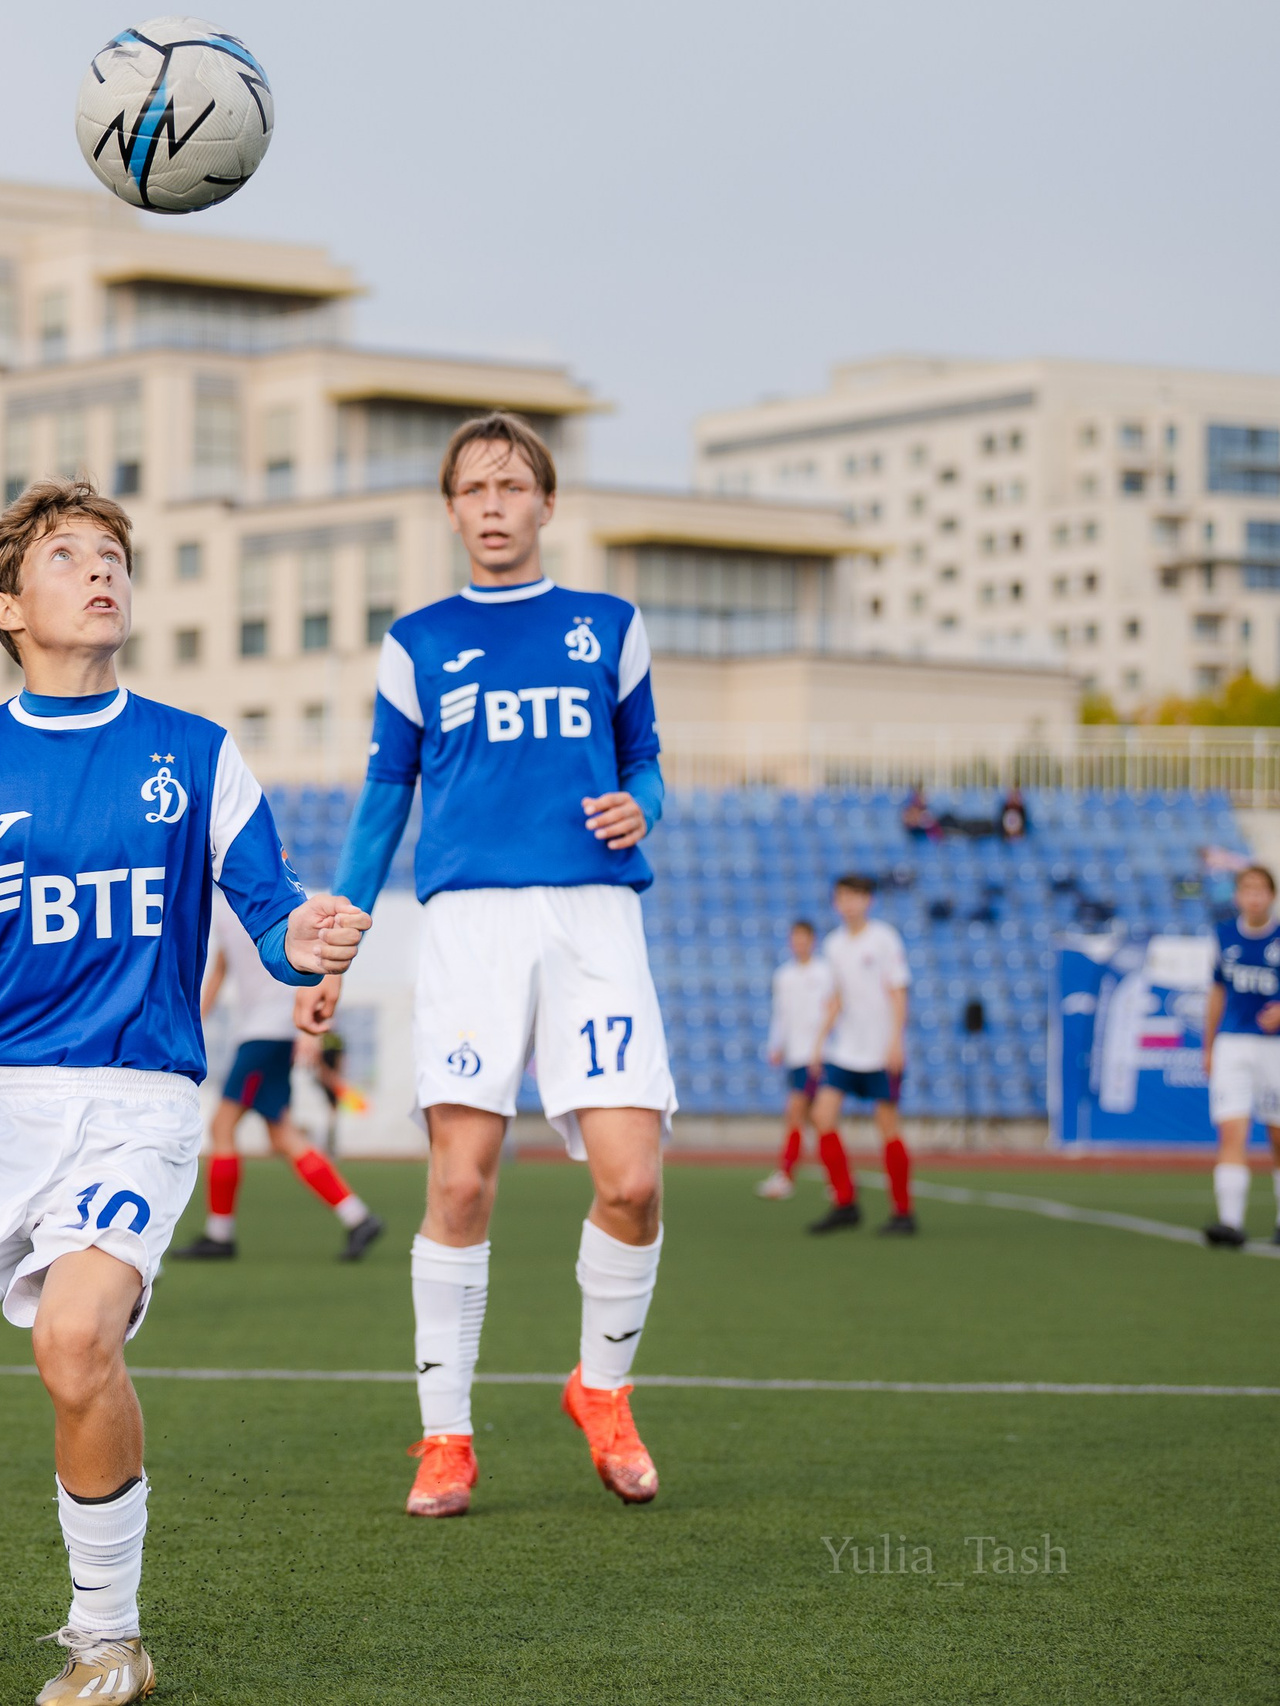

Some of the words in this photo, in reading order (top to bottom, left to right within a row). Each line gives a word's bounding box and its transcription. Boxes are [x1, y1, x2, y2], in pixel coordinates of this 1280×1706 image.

[484, 686, 592, 743] ВТБ
[30, 866, 166, 945] ВТБ
[580, 1016, 633, 1078] 17
